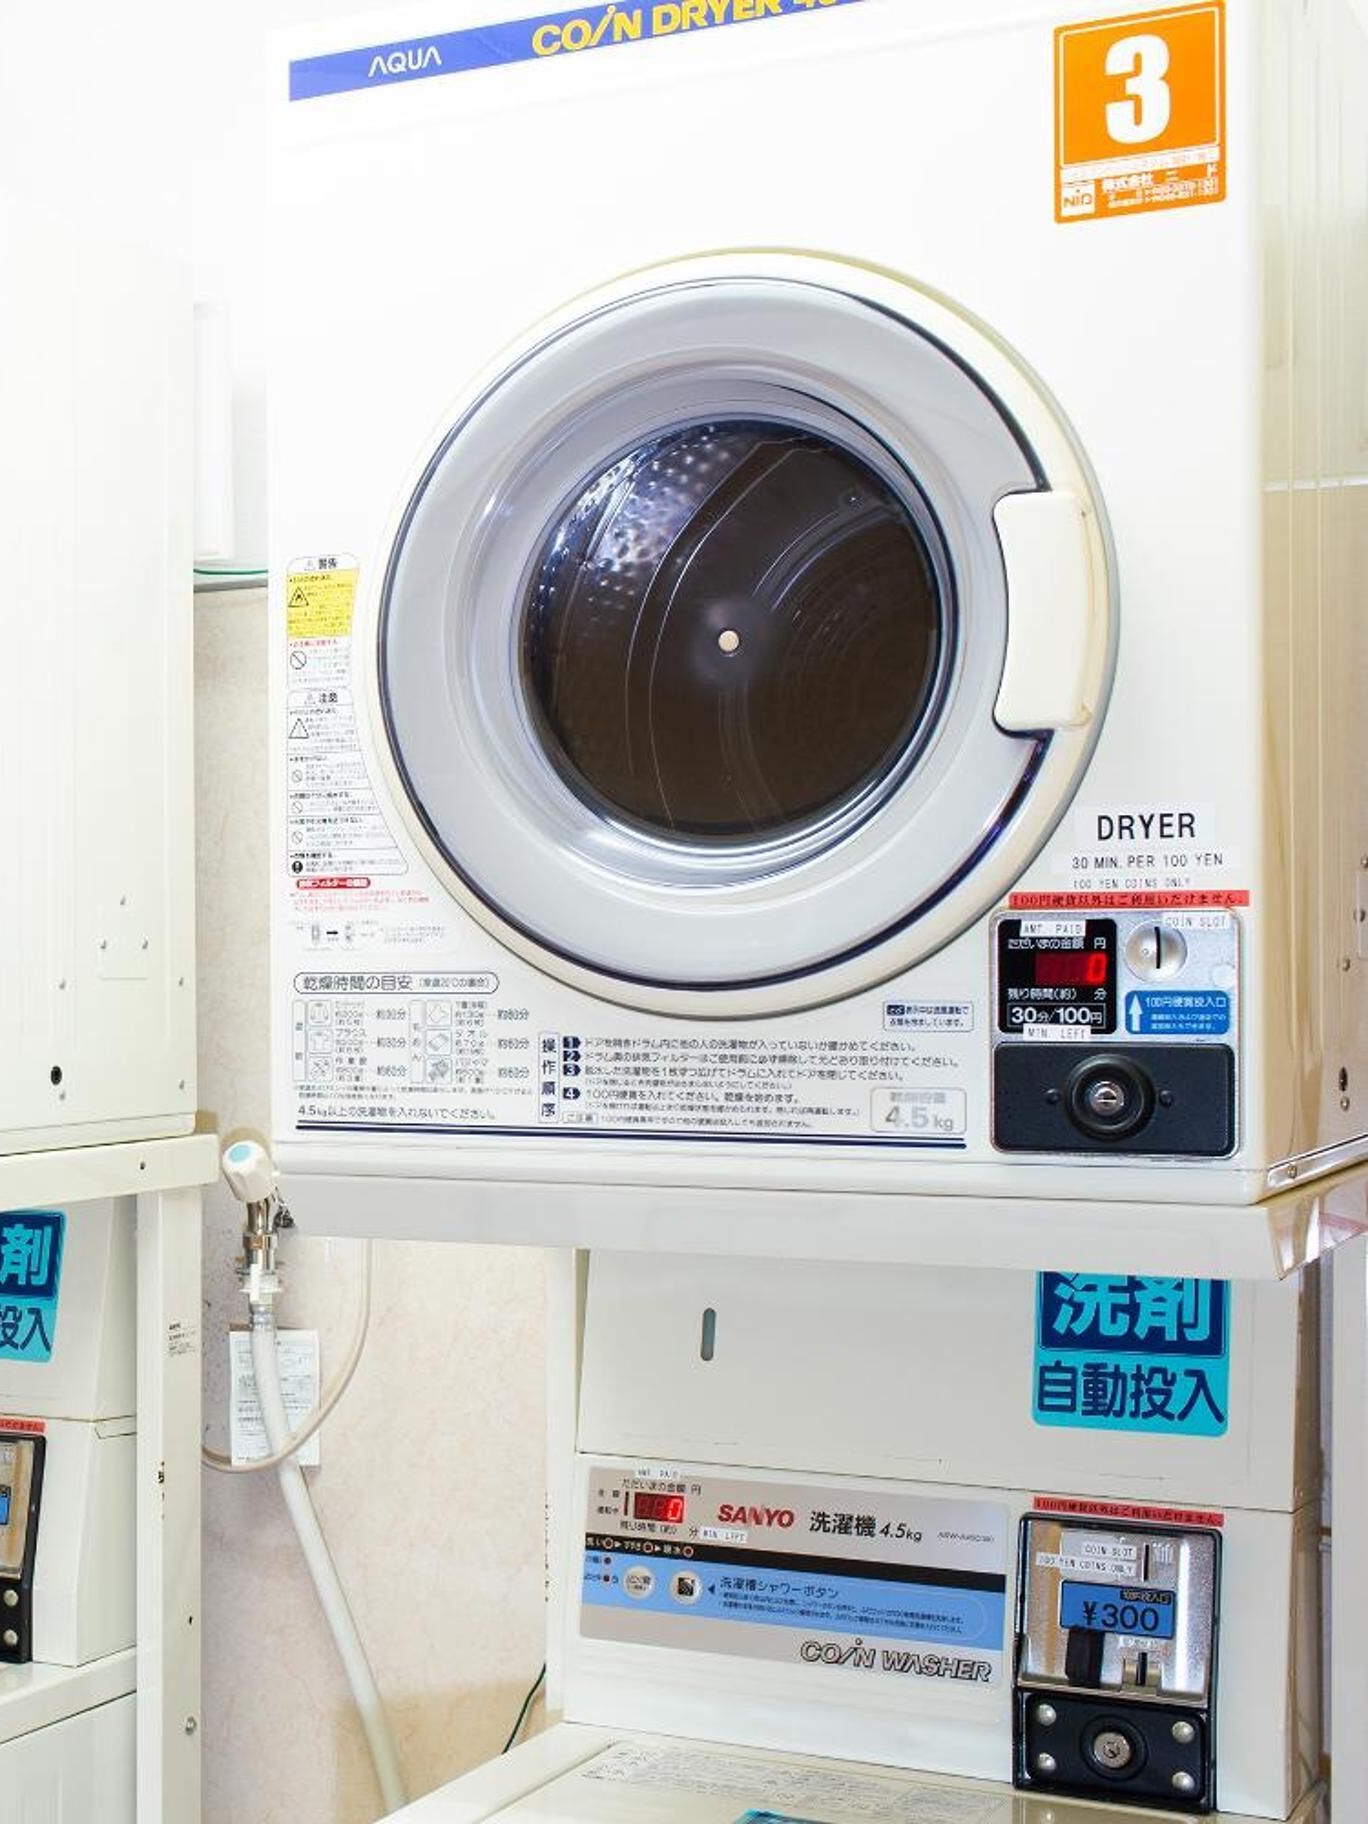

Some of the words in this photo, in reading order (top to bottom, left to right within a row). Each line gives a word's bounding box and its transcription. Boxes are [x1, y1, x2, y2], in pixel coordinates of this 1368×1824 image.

[368, 45, 442, 77] AQUA
[1104, 34, 1171, 144] 3
[1097, 812, 1196, 841] DRYER
[1072, 857, 1088, 869] 30
[1127, 855, 1155, 867] PER
[1164, 854, 1188, 867] 100
[1196, 853, 1223, 866] YEN
[1093, 937, 1107, 949] 円
[1086, 952, 1108, 984] 0
[303, 975, 414, 991] 乾燥時間の目安
[1093, 987, 1107, 1000] 分
[541, 1038, 557, 1118] 操作順序
[565, 1066, 574, 1075] 3
[564, 1088, 574, 1099] 4
[1052, 1272, 1212, 1341] 洗剤
[1037, 1359, 1225, 1424] 自動投入
[690, 1484, 702, 1496] 円
[717, 1503, 795, 1529] SANYO
[809, 1510, 877, 1538] 洗濯機
[879, 1522, 923, 1543] 4.5kg
[688, 1526, 699, 1538] 分
[719, 1576, 840, 1599] 洗濯槽シャワーボタン
[1082, 1600, 1160, 1632] ¥300
[882, 1650, 993, 1683] WASHER
